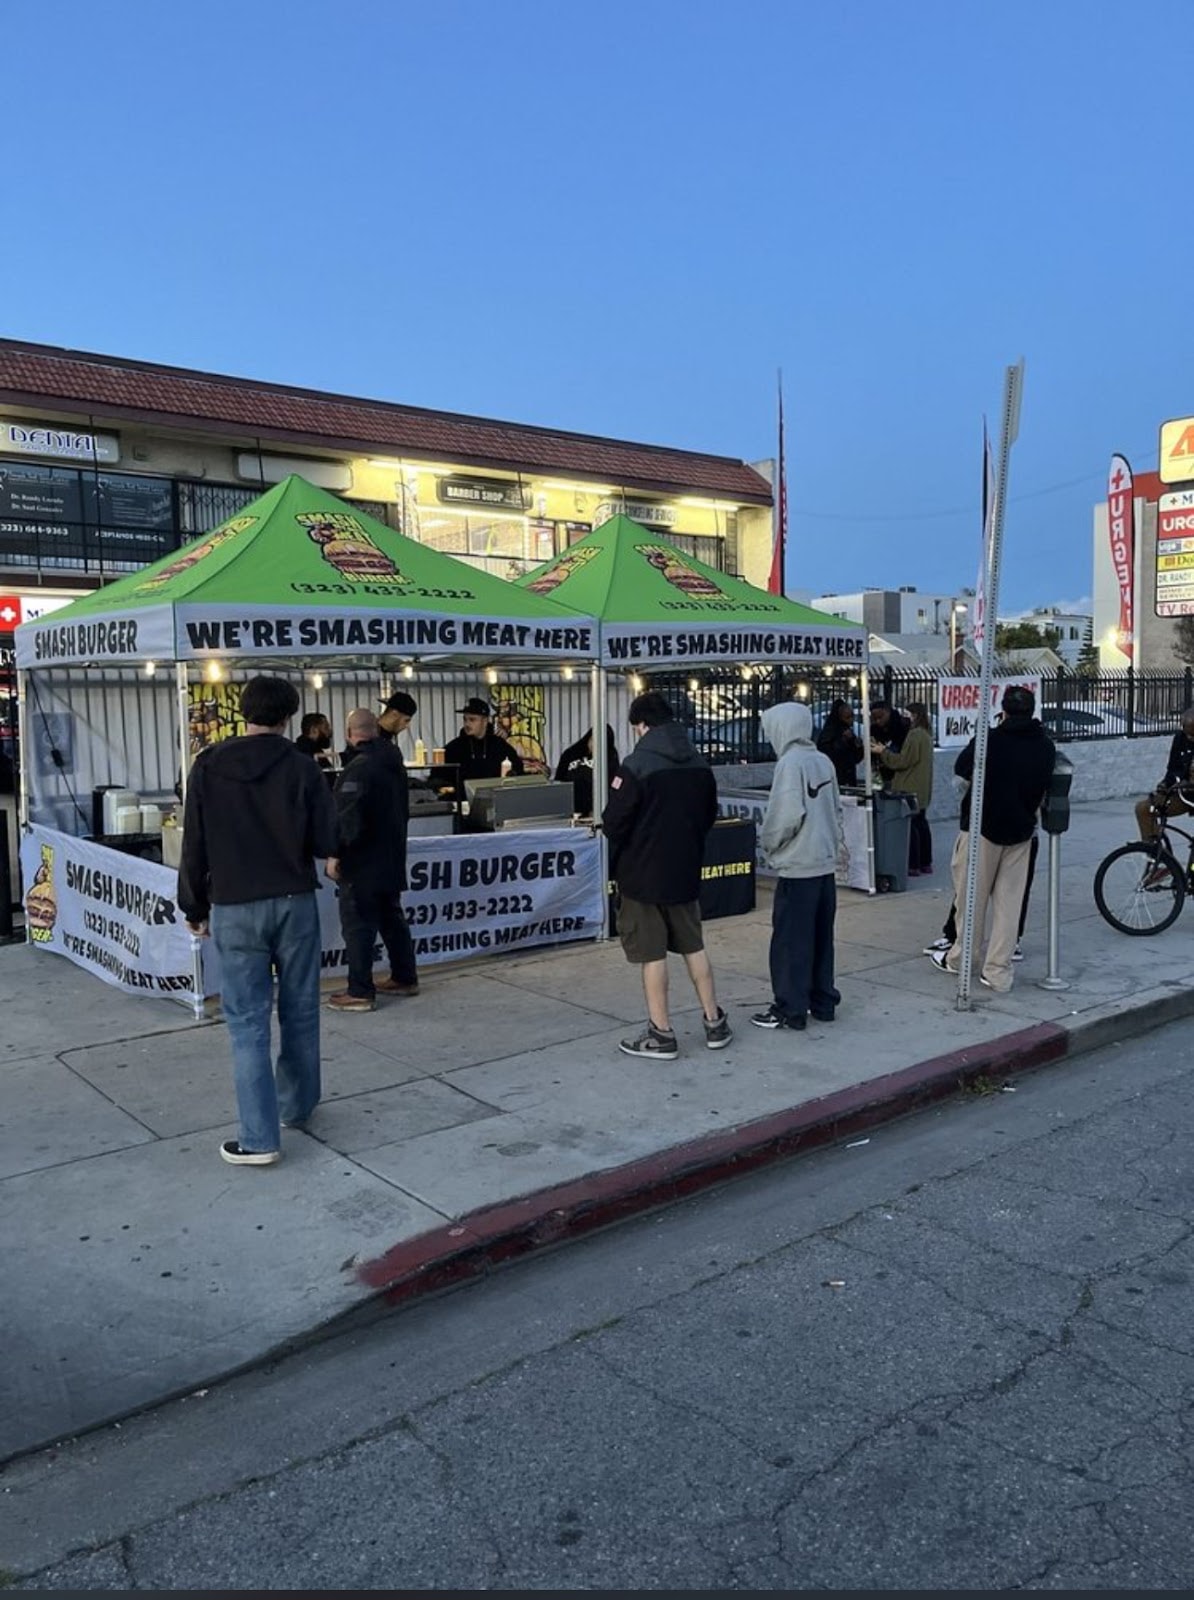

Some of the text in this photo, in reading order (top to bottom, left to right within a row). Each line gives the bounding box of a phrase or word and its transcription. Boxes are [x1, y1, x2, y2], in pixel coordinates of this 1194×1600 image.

[291, 583, 476, 600] (323) 433-2222
[35, 625, 77, 660] SMASH
[78, 619, 137, 656] BURGER
[186, 618, 591, 651] WE'RE SMASHING MEAT HERE
[607, 634, 864, 658] WE'RE SMASHING MEAT HERE
[188, 683, 248, 711] MAS
[490, 685, 544, 712] SMASH
[942, 684, 1000, 710] URGET
[66, 860, 113, 905] SMASH
[459, 850, 576, 887] BURGER
[724, 861, 752, 877] HERE
[399, 894, 533, 925] 23) 433-2222
[412, 930, 492, 955] ASHING
[495, 922, 536, 945] MEAT
[537, 916, 585, 936] HERE
